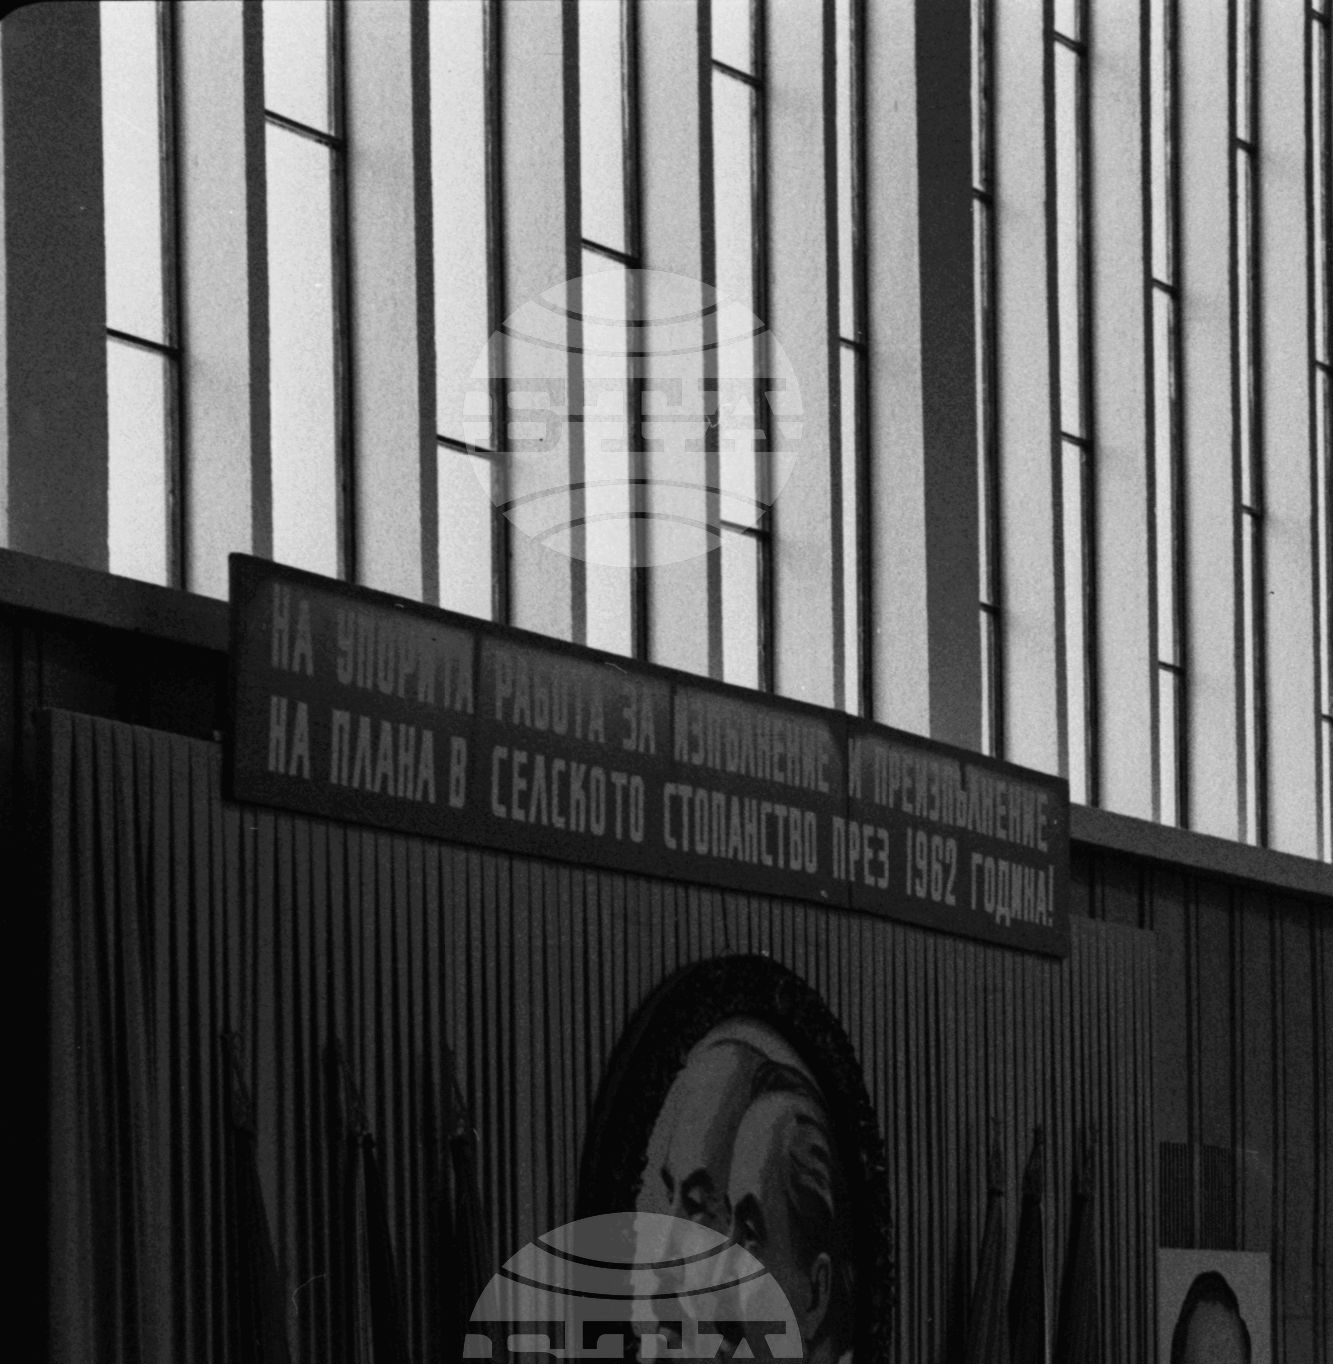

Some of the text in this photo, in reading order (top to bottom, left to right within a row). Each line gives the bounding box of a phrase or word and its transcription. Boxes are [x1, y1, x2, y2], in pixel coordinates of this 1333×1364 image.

[268, 695, 1054, 927] НА ПЛАНА В СЕЛСКОТО СТОПАНСТВО ПРЕЗ 1962 ГОДИНА!
[271, 581, 314, 677] НА
[495, 649, 606, 743] РАБОТА
[622, 676, 656, 756] ЗА
[674, 691, 830, 793] ИЗПЪЛНЕНИЕ
[848, 736, 863, 798] И
[874, 744, 1049, 853] ПРЕИЗПЪЛНЕНИЕ
